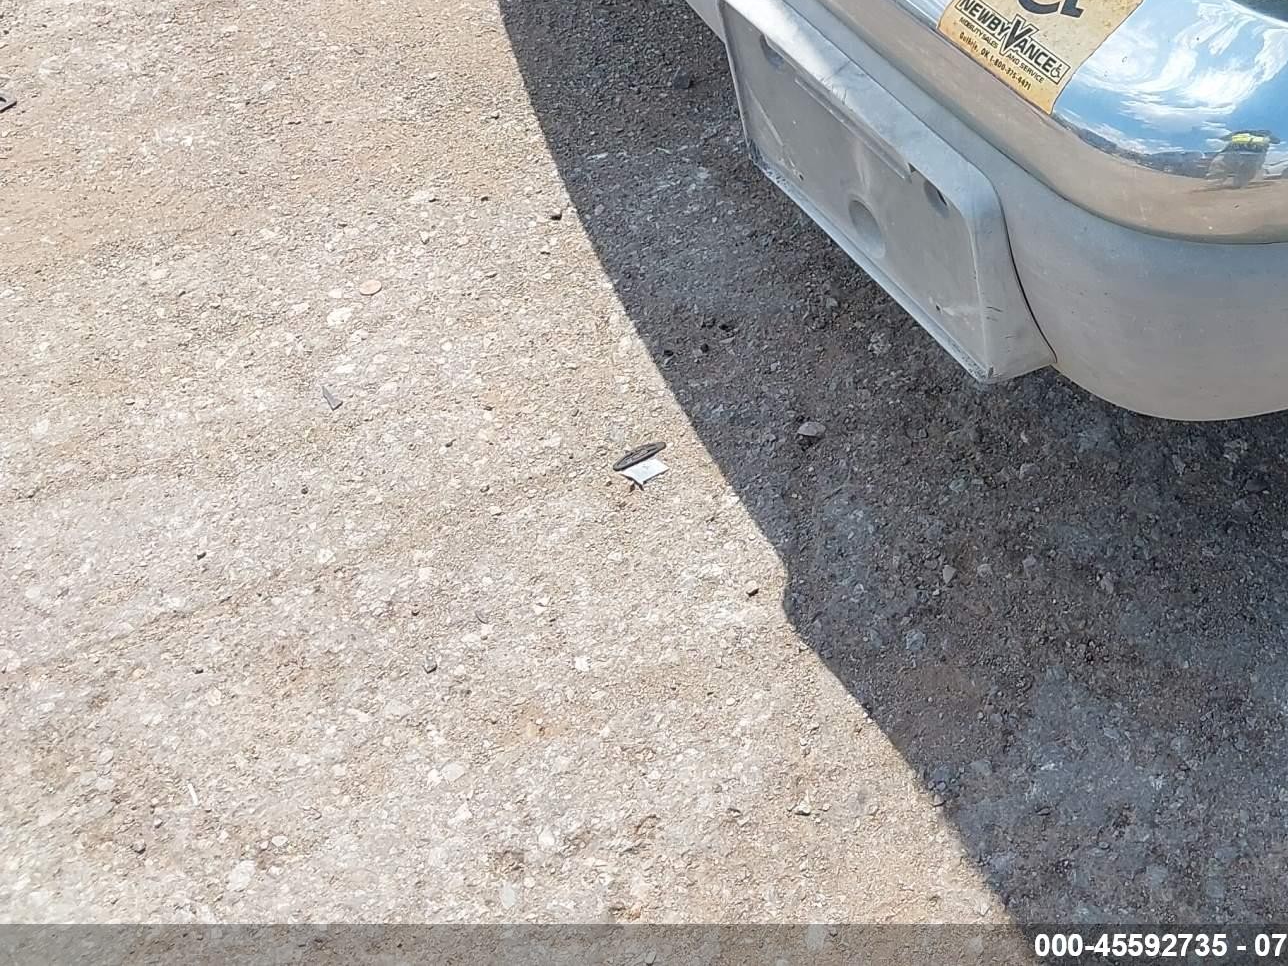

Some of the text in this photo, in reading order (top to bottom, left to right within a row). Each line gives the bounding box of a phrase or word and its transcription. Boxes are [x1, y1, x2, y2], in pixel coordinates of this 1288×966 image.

[980, 47, 991, 60] OK
[981, 33, 999, 49] SALES
[1006, 53, 1020, 66] AND
[1019, 62, 1045, 84] SERVICE
